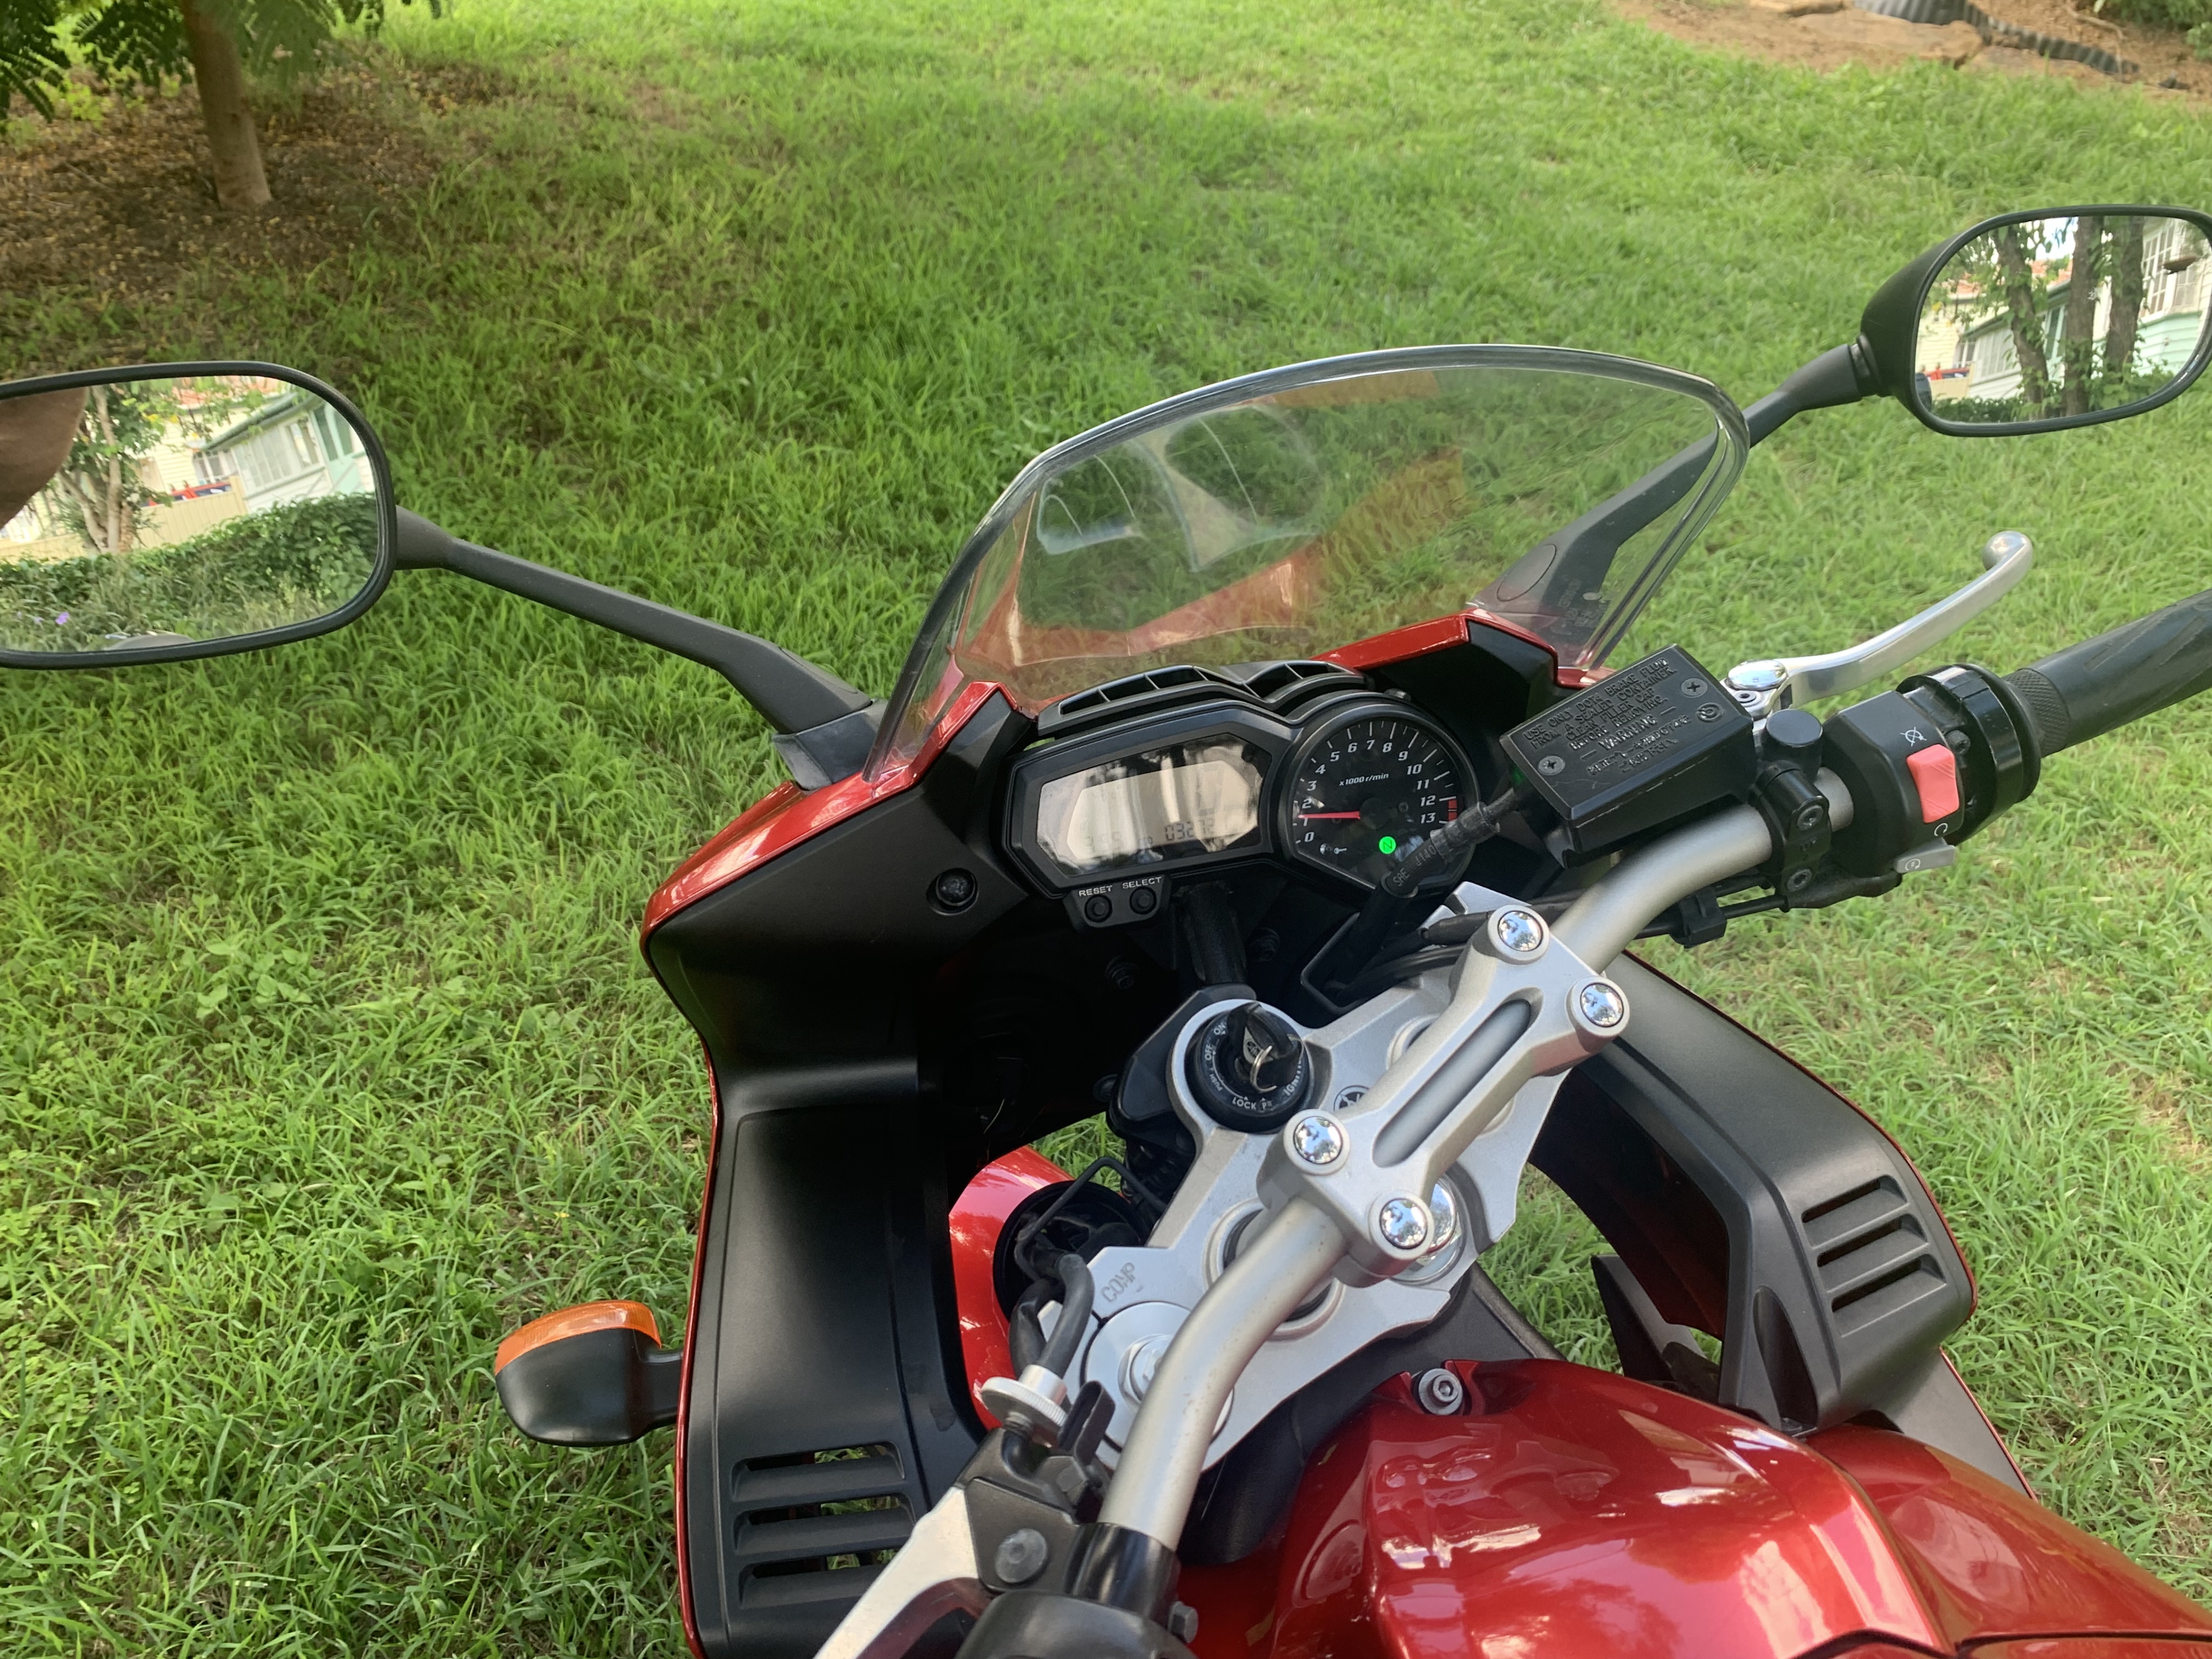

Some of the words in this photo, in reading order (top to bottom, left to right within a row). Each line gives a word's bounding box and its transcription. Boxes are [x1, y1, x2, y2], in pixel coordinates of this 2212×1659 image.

[1522, 724, 1547, 740] USE
[1547, 708, 1573, 727] ONLY
[1575, 692, 1602, 712] DOT4
[1604, 673, 1638, 696] BRAKE
[1639, 657, 1668, 677] FLUID
[1565, 719, 1599, 741] CLEAN
[1600, 700, 1634, 723] FILLER
[1635, 687, 1654, 703] CAP
[1530, 729, 1561, 749] FROM
[1564, 721, 1575, 731] A
[1574, 698, 1613, 724] SEALED
[1569, 724, 1610, 751] BEFORE
[1598, 714, 1658, 751] WARNING
[1347, 742, 1358, 753] 6
[1367, 739, 1375, 750] 7
[1383, 742, 1392, 753] 8
[1330, 751, 1340, 762] 5
[1398, 751, 1408, 761] 9
[1315, 764, 1326, 774] 4
[1407, 764, 1422, 775] 10
[1365, 772, 1389, 782] r/min
[1306, 780, 1317, 791] 3
[1417, 778, 1430, 790] 11
[1302, 798, 1312, 809] 2
[1420, 795, 1436, 806] 12
[1420, 812, 1436, 823] 13
[1305, 831, 1315, 842] 0
[1122, 876, 1162, 889] SELECT
[1393, 867, 1410, 887] SAE
[1079, 885, 1113, 896] RESET
[1214, 1022, 1227, 1035] ON
[1204, 1044, 1212, 1061] OFF
[1209, 1074, 1223, 1091] PUSH
[1232, 1097, 1256, 1110] LOCK
